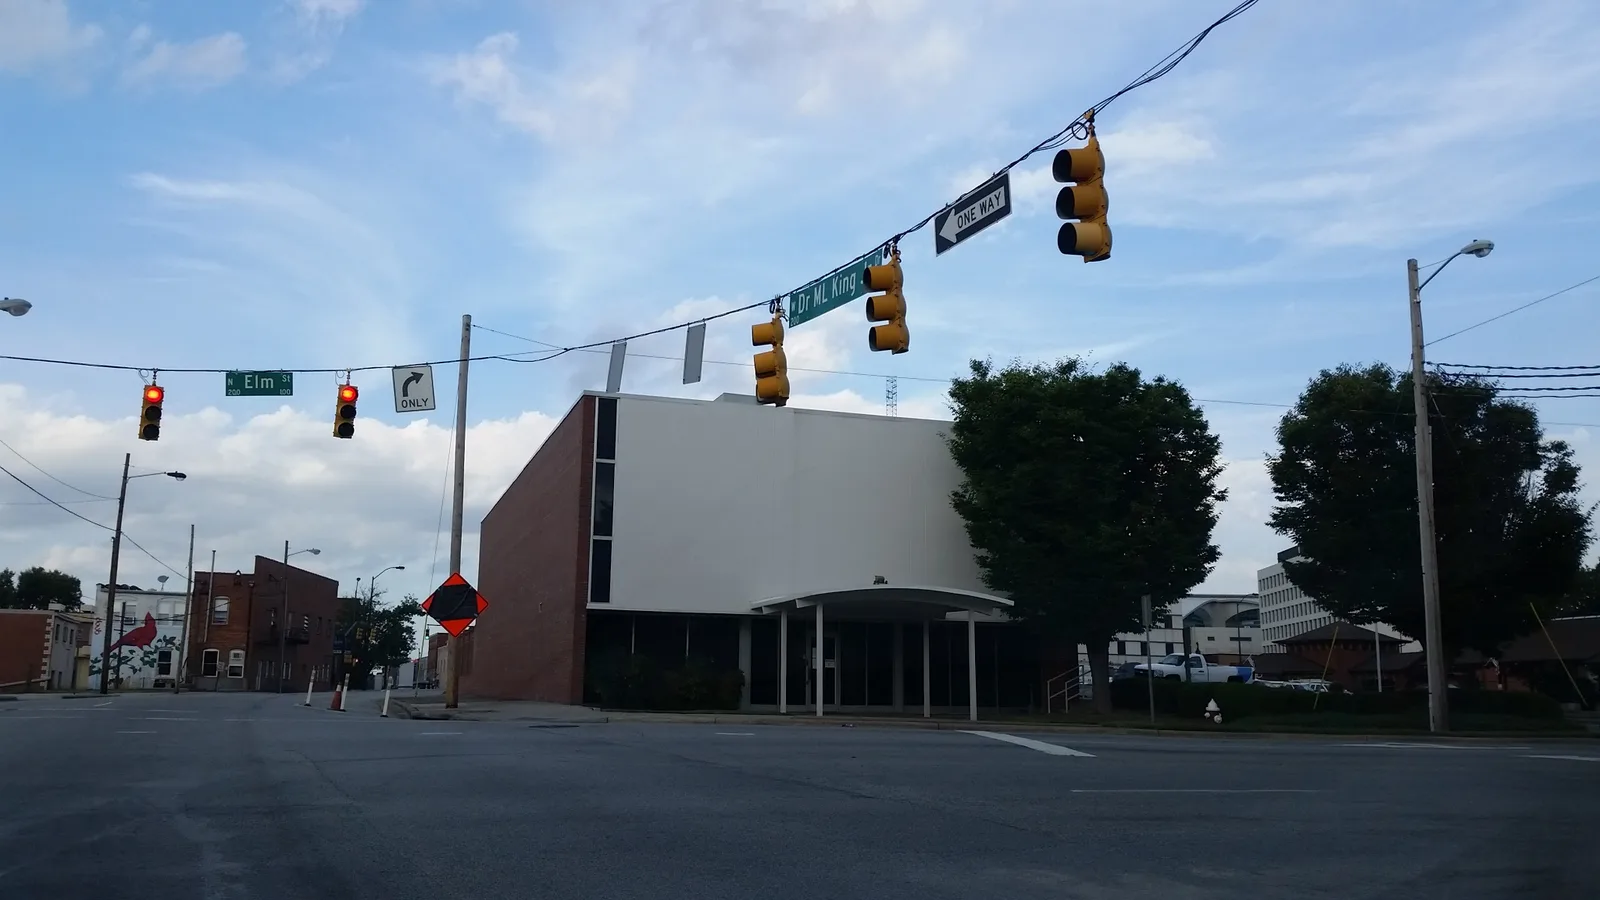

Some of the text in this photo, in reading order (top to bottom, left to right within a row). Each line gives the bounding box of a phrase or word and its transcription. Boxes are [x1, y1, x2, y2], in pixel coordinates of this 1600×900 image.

[957, 190, 1002, 229] ONE WAY
[798, 292, 811, 314] Dr
[813, 281, 828, 308] ML
[831, 271, 857, 299] King
[227, 374, 291, 389] N Elm St
[401, 397, 429, 409] ONLY
